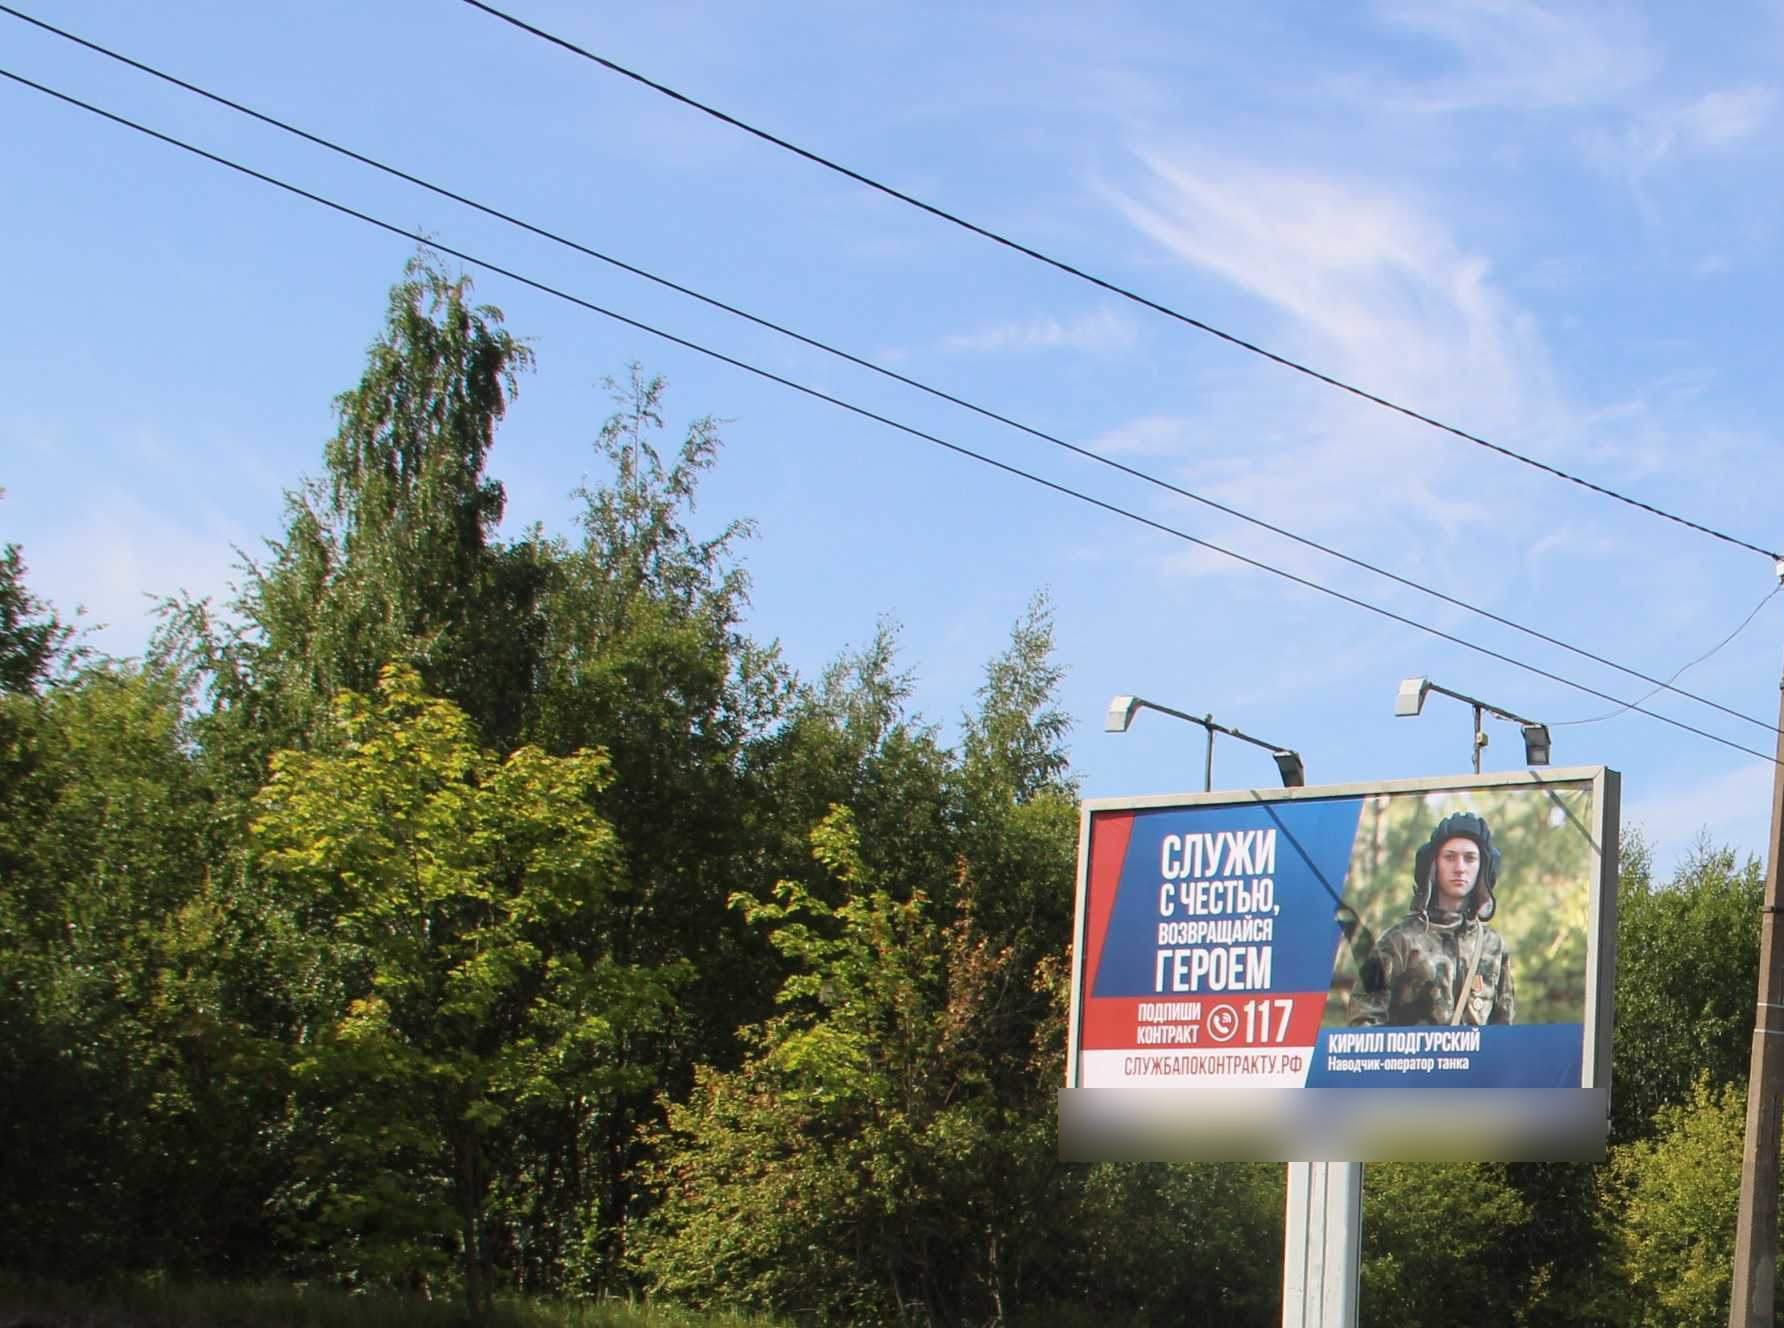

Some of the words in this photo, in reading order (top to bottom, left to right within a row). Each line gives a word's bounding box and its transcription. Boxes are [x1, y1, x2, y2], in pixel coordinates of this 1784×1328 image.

[1161, 829, 1276, 879] СЛУЖИ
[1160, 883, 1175, 916] С
[1180, 878, 1280, 916] ЧЕСТЬЮ,
[1158, 915, 1273, 945] ВОЗВРАЩАЙСЯ
[1155, 946, 1273, 992] ГЕРОЕМ
[1138, 1002, 1201, 1023] ПОДПИШИ
[1243, 999, 1293, 1043] 117
[1136, 1025, 1200, 1044] КОНТРАКТ
[1328, 1032, 1384, 1053] КИРИЛЛ
[1387, 1028, 1480, 1054] ПОДГУРСКИЙ
[1124, 1054, 1303, 1076] СЛУЖБАПОКОНТРАКТУ.РФ
[1327, 1056, 1435, 1073] Наводчик-оператор
[1437, 1057, 1470, 1071] танка
